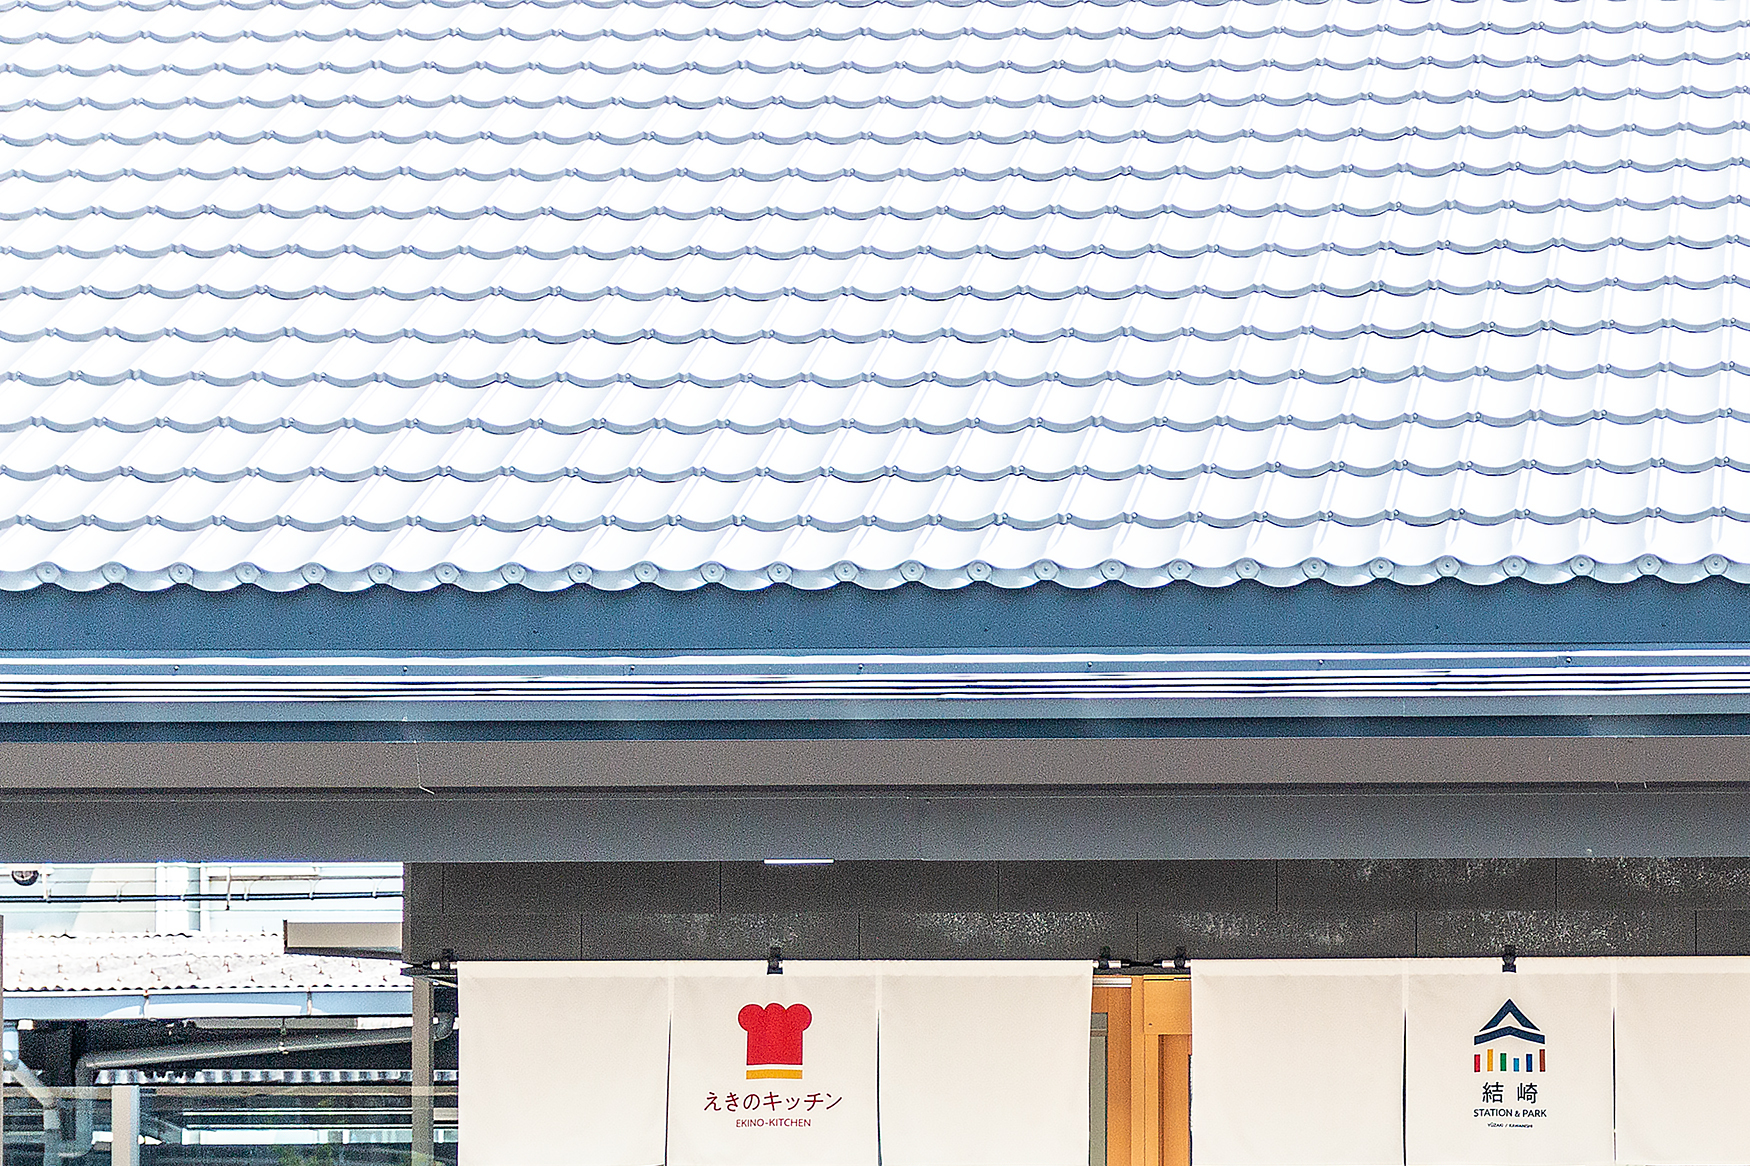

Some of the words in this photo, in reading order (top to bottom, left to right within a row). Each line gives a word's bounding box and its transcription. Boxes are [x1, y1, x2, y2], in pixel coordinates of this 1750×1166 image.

[1482, 1081, 1538, 1104] 結崎
[703, 1091, 842, 1112] えきのキッチン
[1473, 1108, 1512, 1117] STATION
[1522, 1109, 1547, 1117] PARK
[735, 1118, 811, 1127] EKINO-KITCHEN
